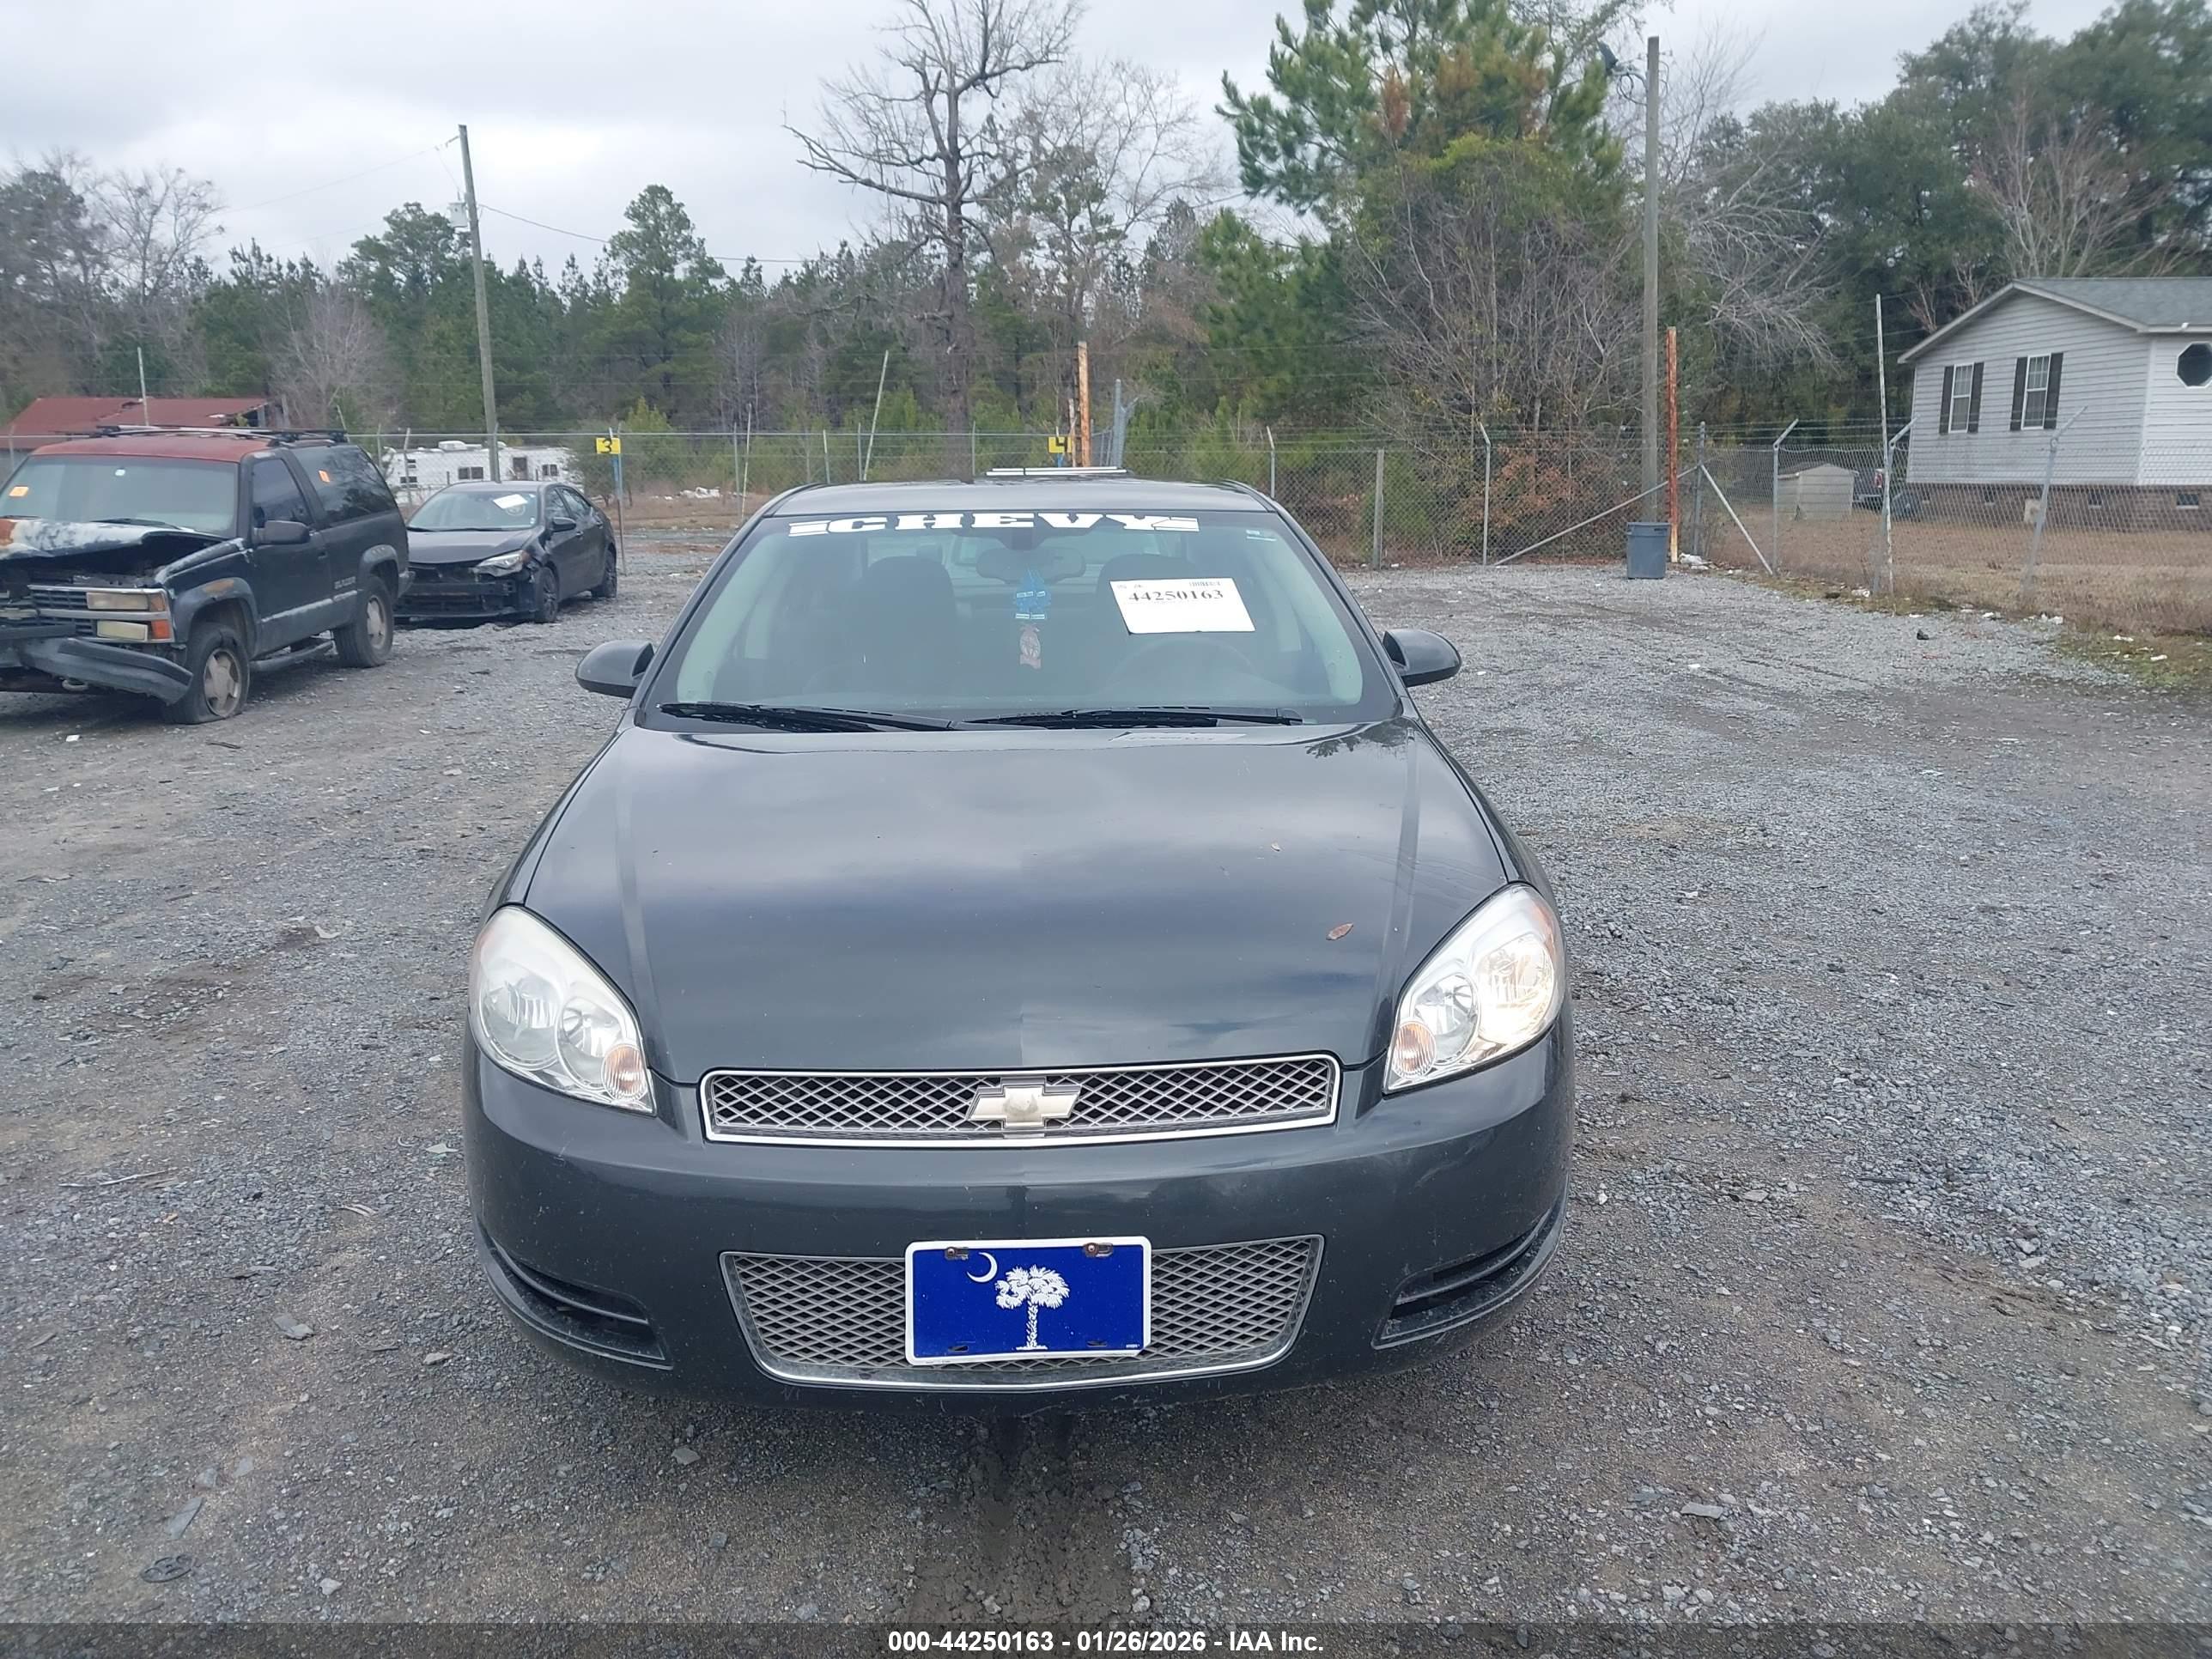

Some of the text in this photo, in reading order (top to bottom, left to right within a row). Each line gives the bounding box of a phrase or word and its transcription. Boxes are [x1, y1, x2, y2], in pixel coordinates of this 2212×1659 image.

[600, 437, 612, 453] 3
[1055, 436, 1067, 453] 4
[827, 513, 1178, 532] CHEVY
[1128, 590, 1224, 601] 44250163
